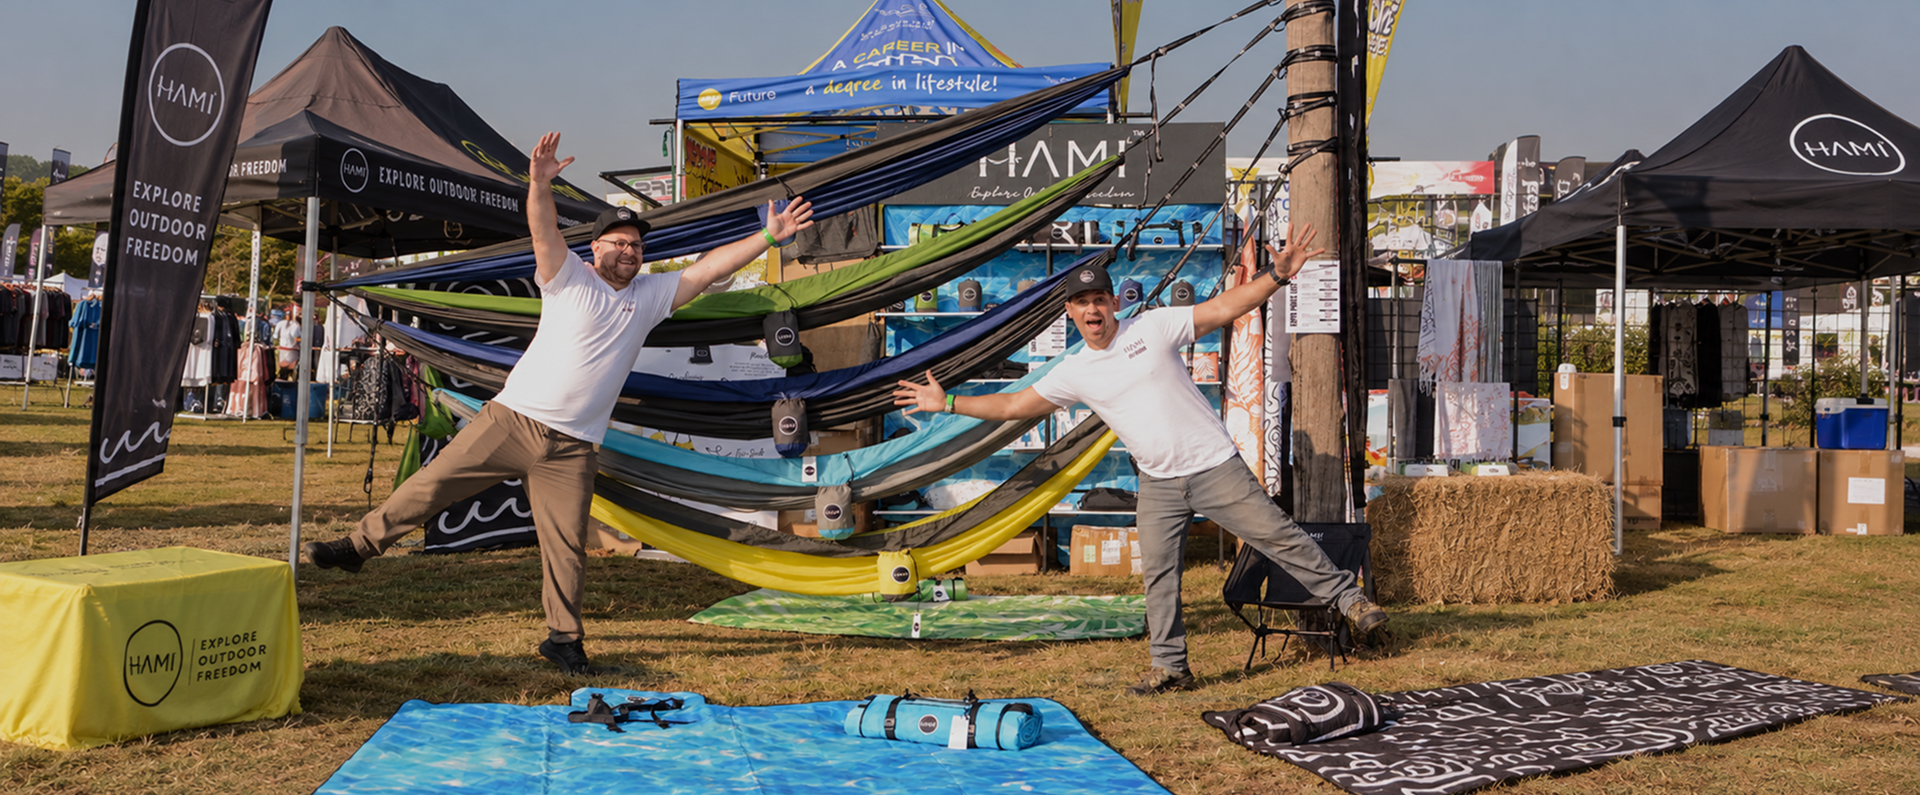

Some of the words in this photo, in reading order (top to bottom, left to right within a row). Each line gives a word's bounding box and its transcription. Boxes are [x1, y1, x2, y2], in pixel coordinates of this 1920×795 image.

[832, 60, 847, 71] A
[157, 75, 217, 115] HAMI
[729, 90, 776, 103] Future
[805, 85, 815, 96] a
[823, 79, 884, 98] degree
[892, 74, 907, 91] in
[916, 73, 998, 95] lifestyle!
[978, 140, 1126, 178] HAMI
[1803, 140, 1890, 158] HAMI
[240, 158, 288, 177] FREEDOM
[343, 162, 367, 178] HAMI
[132, 180, 202, 213] EXPLORE
[379, 166, 426, 192] EXPLORE
[480, 190, 519, 213] FREEDOM
[129, 208, 207, 241] OUTDOOR
[126, 236, 199, 266] FREEDOM
[200, 630, 258, 651] EXPLORE
[129, 652, 177, 676] HAMI
[198, 644, 267, 666] OUTDOOR
[196, 660, 262, 682] FREEDOM
